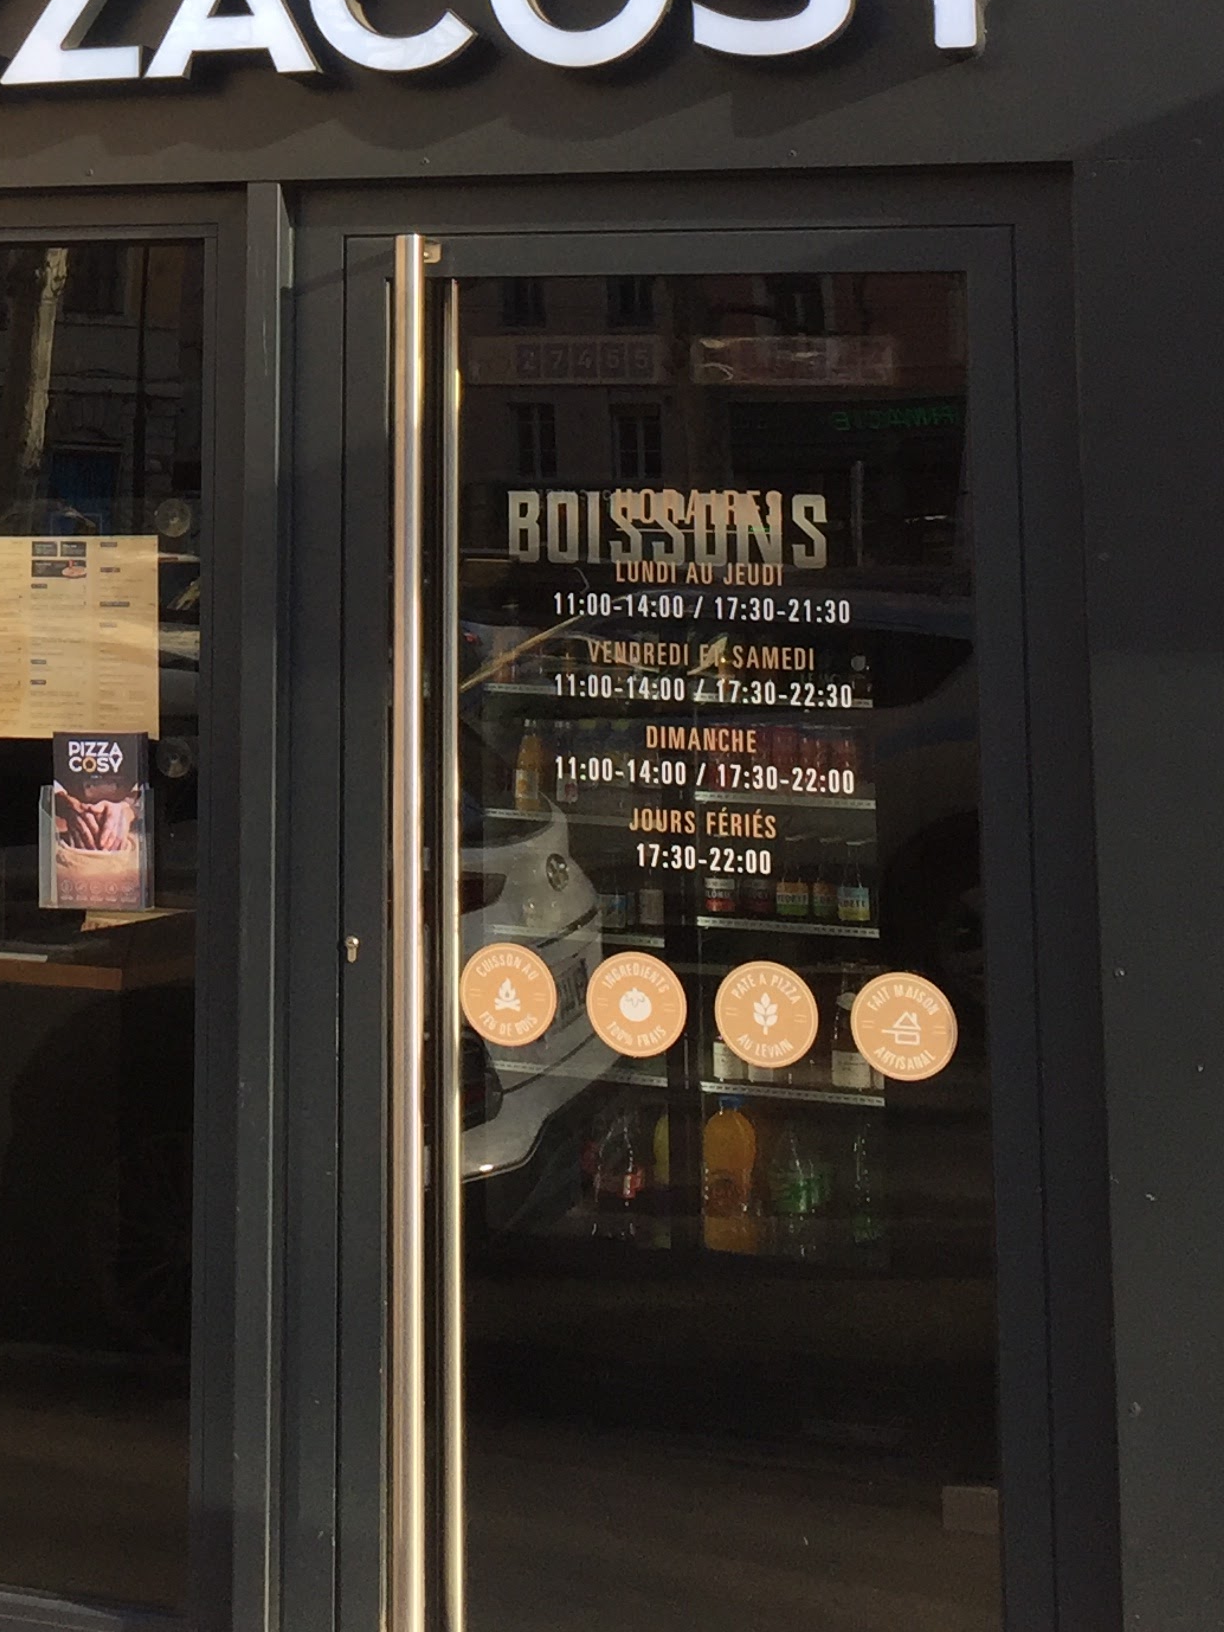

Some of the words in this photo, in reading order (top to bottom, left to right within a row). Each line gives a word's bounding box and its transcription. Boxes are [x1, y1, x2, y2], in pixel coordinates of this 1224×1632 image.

[507, 489, 828, 569] BOISSONS
[616, 560, 677, 584] LUNDI
[686, 562, 714, 585] AU
[723, 563, 783, 586] JEUDI
[554, 592, 685, 619] 11:00-14:00
[715, 596, 851, 624] 17:30-21:30
[587, 640, 689, 666] VENDREDI
[732, 645, 815, 671] SAMEDI
[554, 674, 686, 702] 11:00-14:00
[716, 679, 853, 709] 17:30-22:30
[68, 741, 123, 757] PIZZA
[645, 726, 757, 753] DIMANCHE
[68, 755, 124, 773] COSY
[555, 756, 687, 786] 11:00-14:00
[717, 763, 855, 795] 17:30-22:00
[629, 808, 696, 835] JOURS
[706, 806, 777, 839] FÉRIÉS
[636, 843, 772, 875] 17:30-22:00
[476, 953, 522, 977] CUISSON
[521, 963, 540, 981] AU
[770, 974, 797, 1005] PIZZA
[867, 986, 891, 1011] FAIT
[893, 984, 940, 1016] MAISON
[478, 1010, 497, 1031] FEU
[500, 1022, 512, 1037] DE
[514, 1013, 538, 1035] BOIS
[637, 1024, 667, 1047] FRAIS
[737, 1033, 753, 1051] AU
[755, 1038, 794, 1063] LEVAIN
[874, 1046, 935, 1070] ARTISANAL
